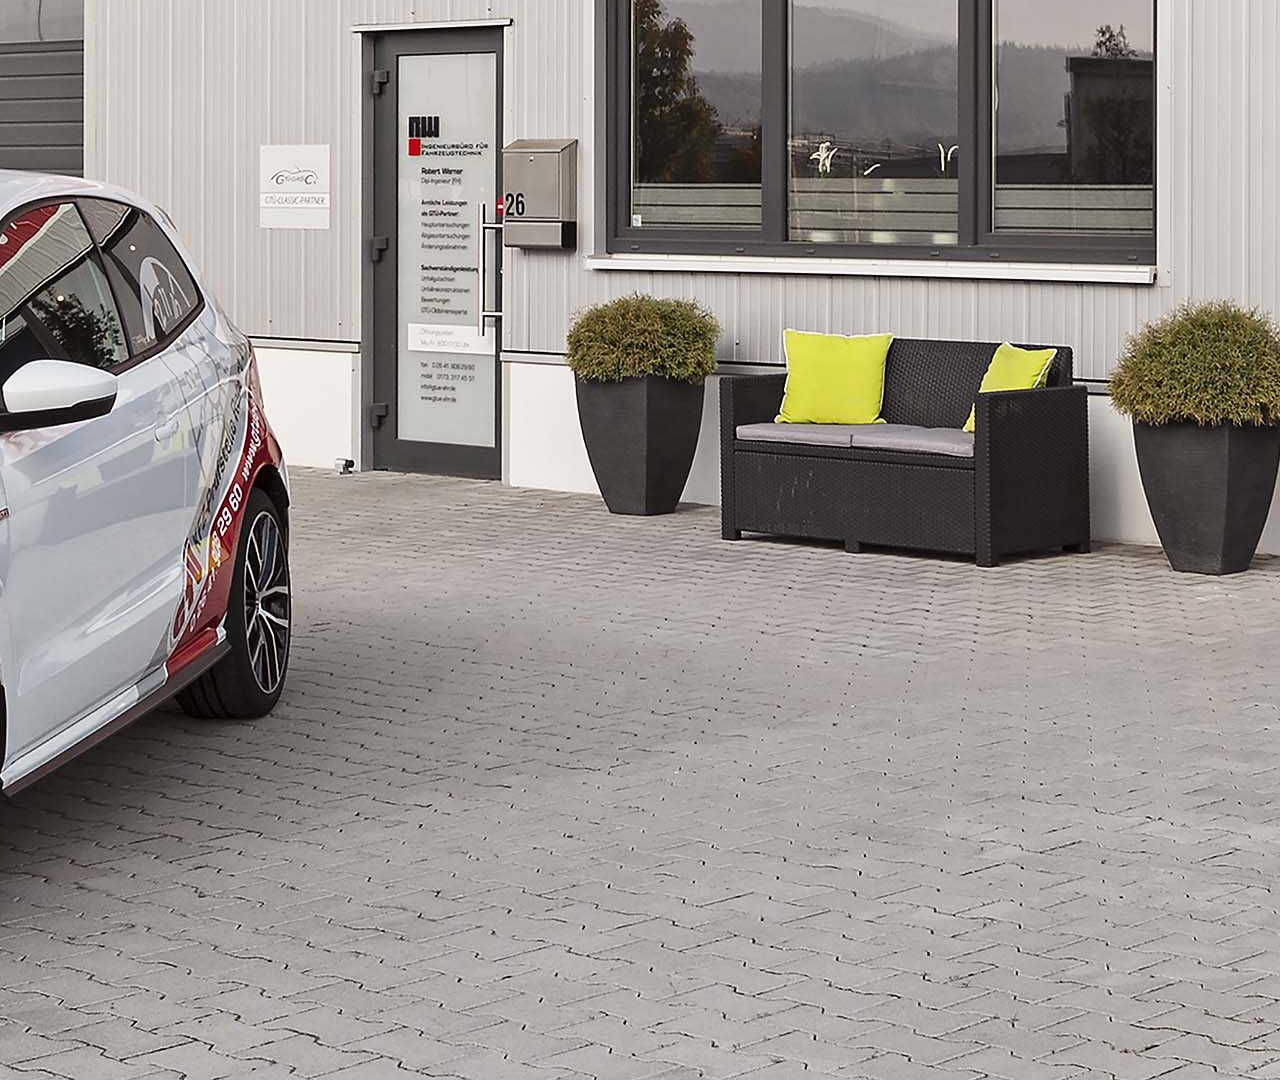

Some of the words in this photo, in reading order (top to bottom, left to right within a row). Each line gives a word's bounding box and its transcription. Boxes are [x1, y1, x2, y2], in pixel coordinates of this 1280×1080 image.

[505, 193, 525, 216] 26
[217, 507, 233, 536] 29
[228, 483, 242, 512] 60
